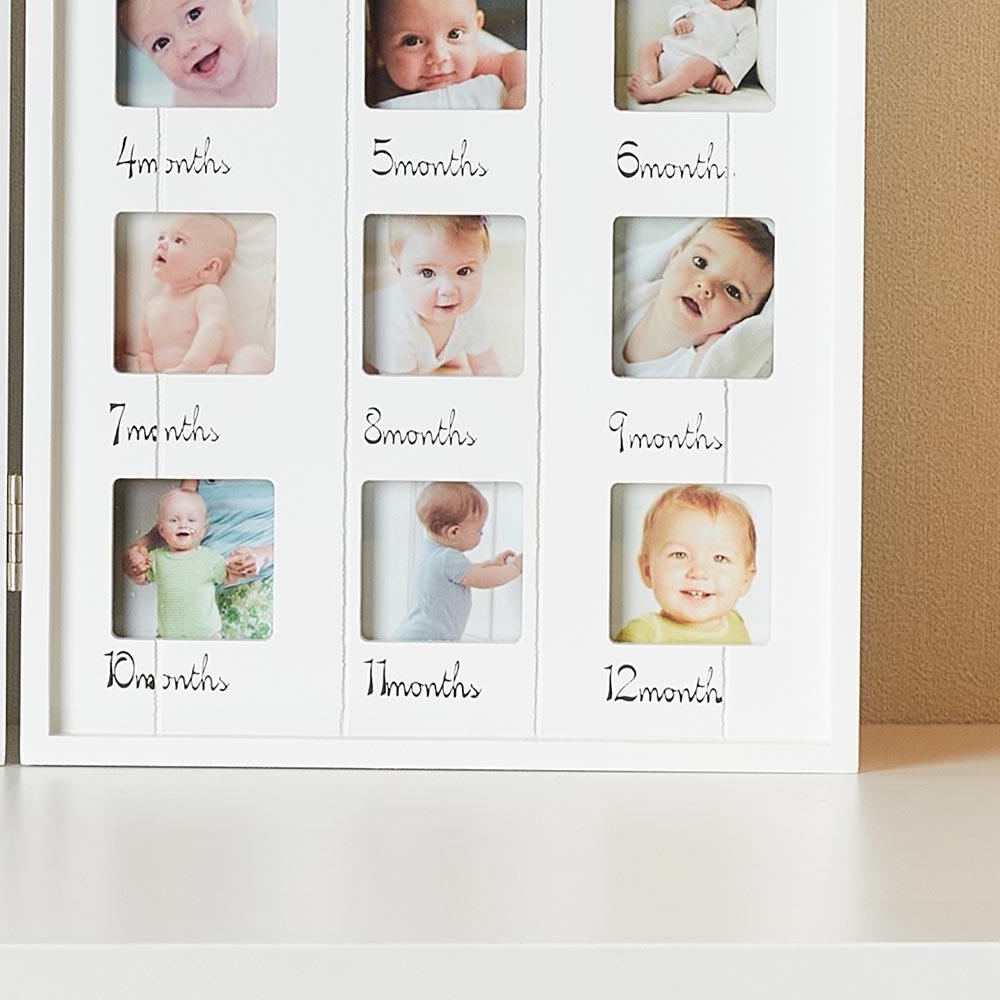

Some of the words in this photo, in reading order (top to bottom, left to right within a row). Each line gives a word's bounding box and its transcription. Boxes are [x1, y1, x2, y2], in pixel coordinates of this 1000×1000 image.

[371, 137, 488, 178] 5months
[616, 140, 735, 180] 6month
[364, 406, 477, 447] 8months
[608, 410, 723, 453] 9months
[363, 657, 482, 699] 11months
